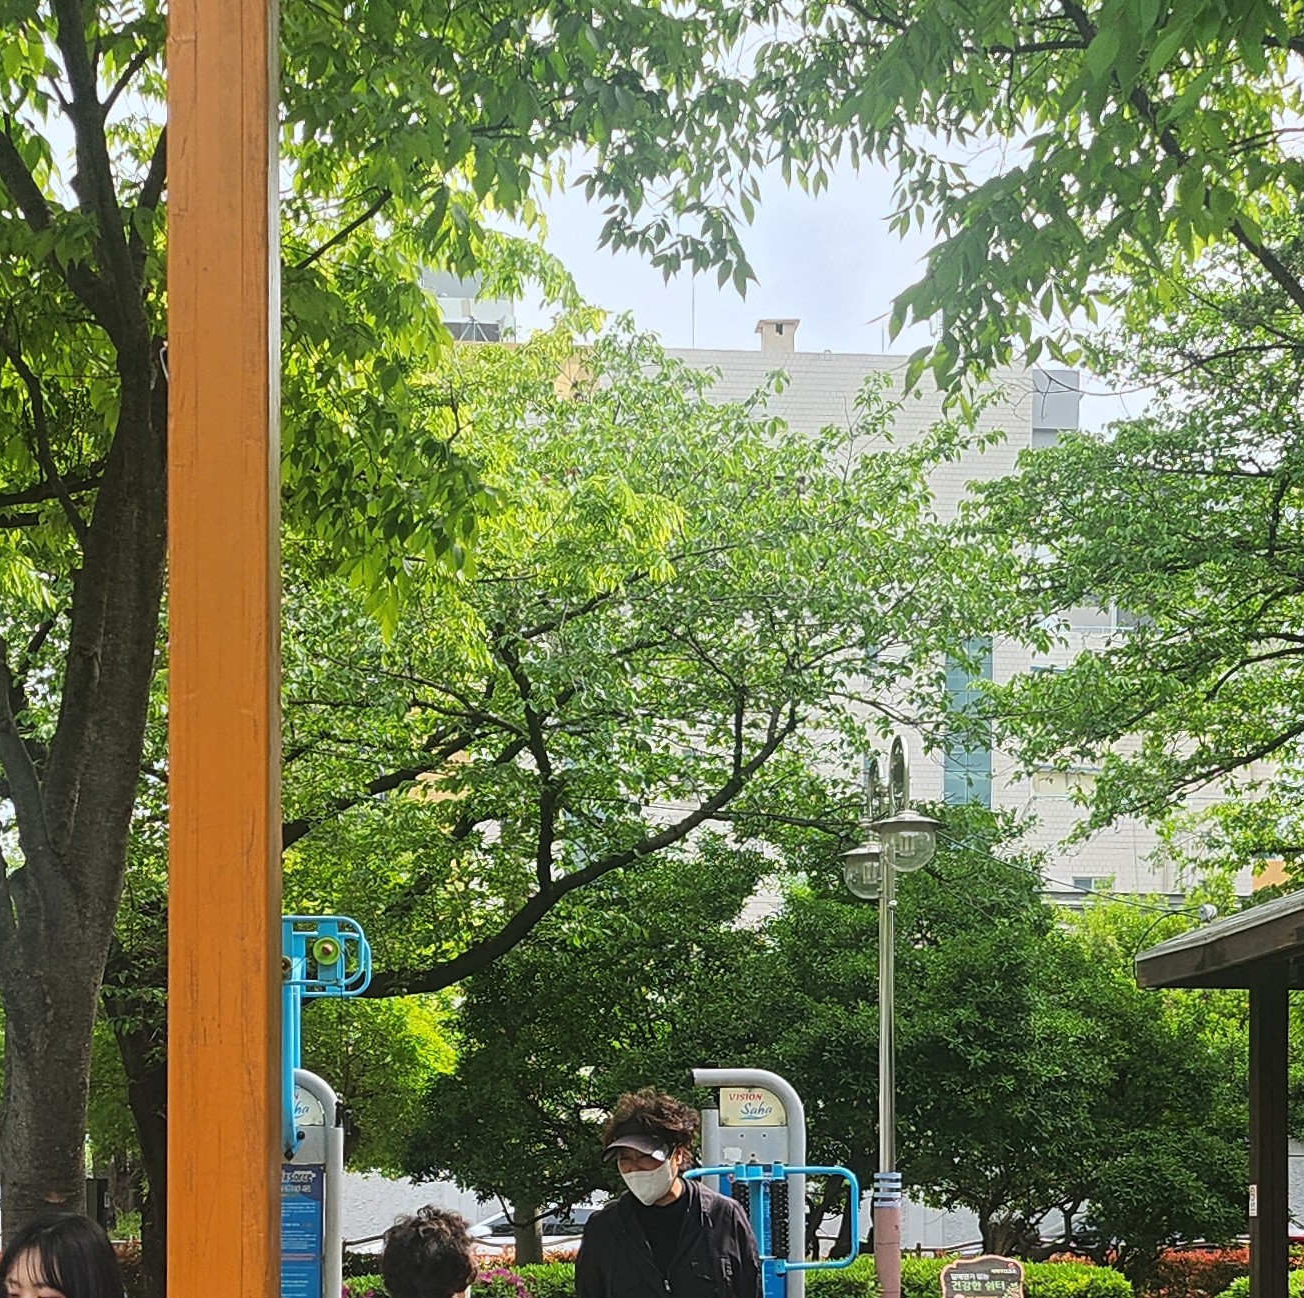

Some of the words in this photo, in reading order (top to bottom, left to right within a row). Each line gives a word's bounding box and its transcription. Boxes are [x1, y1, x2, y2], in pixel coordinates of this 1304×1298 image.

[728, 1093, 763, 1101] VISION
[740, 1101, 773, 1115] Saha
[951, 1280, 982, 1291] 건강한
[984, 1280, 1006, 1291] 쉼터
